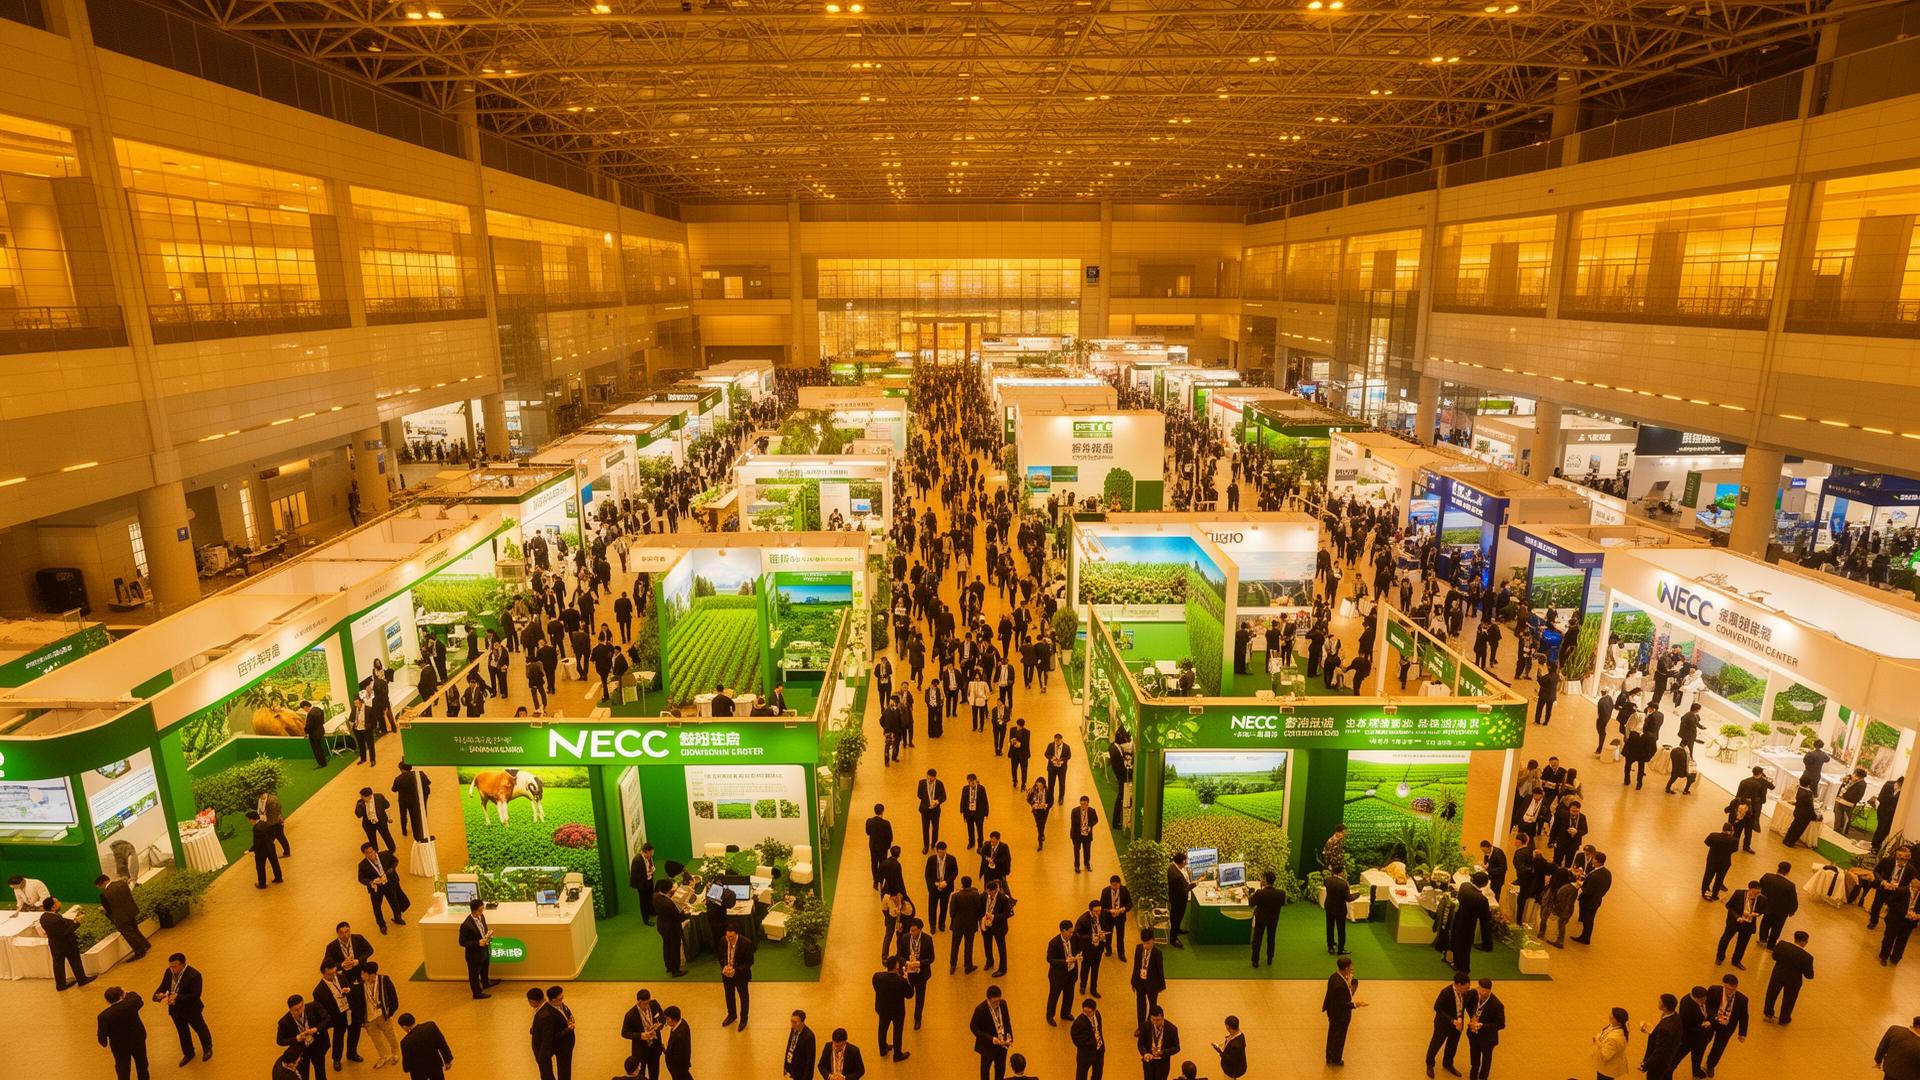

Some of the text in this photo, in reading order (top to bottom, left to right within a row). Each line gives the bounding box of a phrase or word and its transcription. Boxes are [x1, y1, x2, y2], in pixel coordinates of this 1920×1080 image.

[1660, 582, 1714, 626] NECC
[1765, 646, 1799, 668] CENTER
[1231, 715, 1278, 730] NECC
[548, 729, 670, 759] NECC
